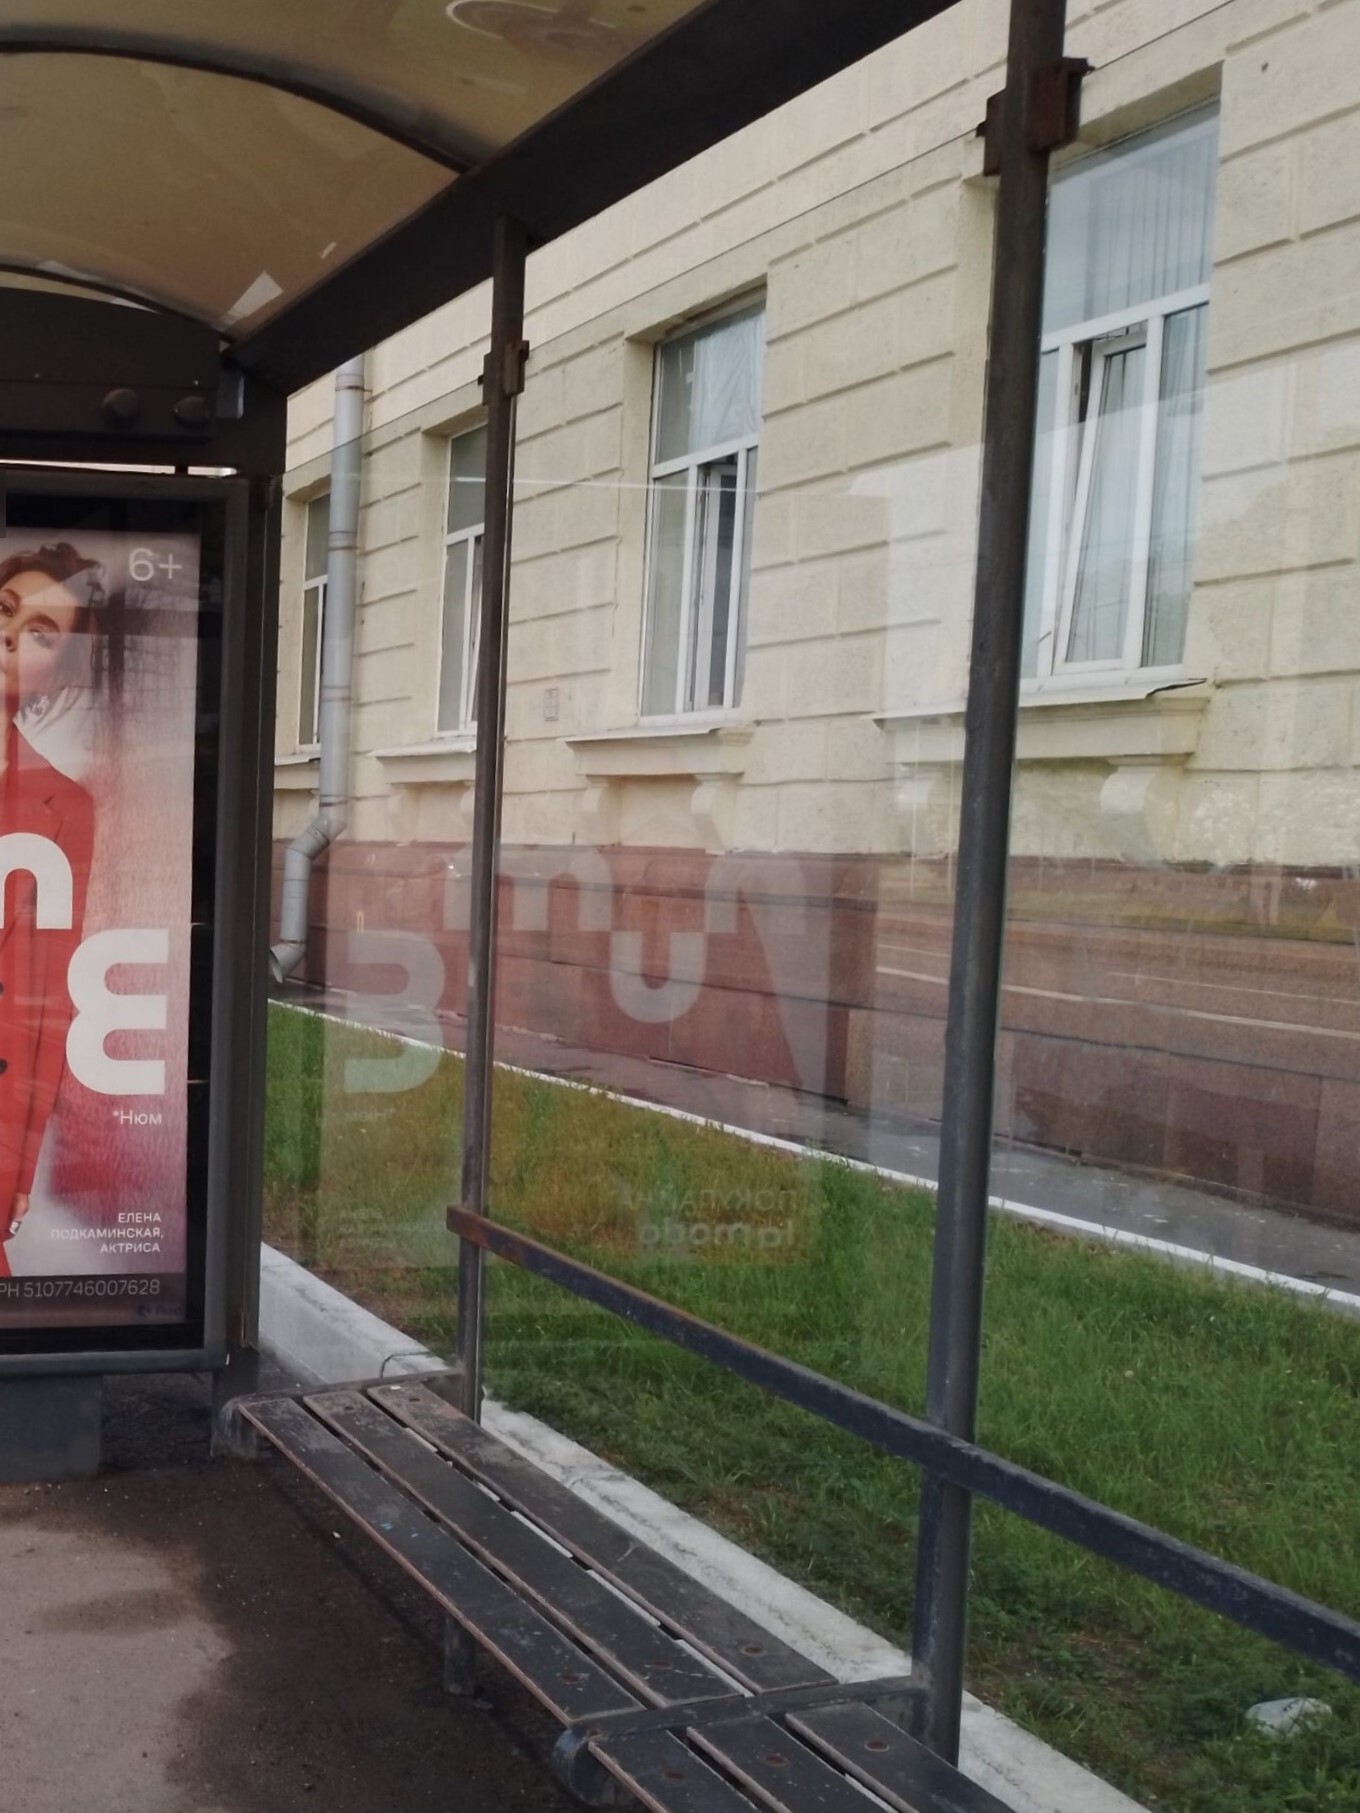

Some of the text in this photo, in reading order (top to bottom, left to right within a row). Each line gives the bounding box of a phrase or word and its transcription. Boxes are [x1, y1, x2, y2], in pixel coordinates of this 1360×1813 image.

[128, 547, 183, 582] 6+
[118, 1213, 161, 1223] ЕЛЕНА
[100, 1242, 160, 1254] АКТРИСА
[23, 1279, 161, 1298] 5107746007628
